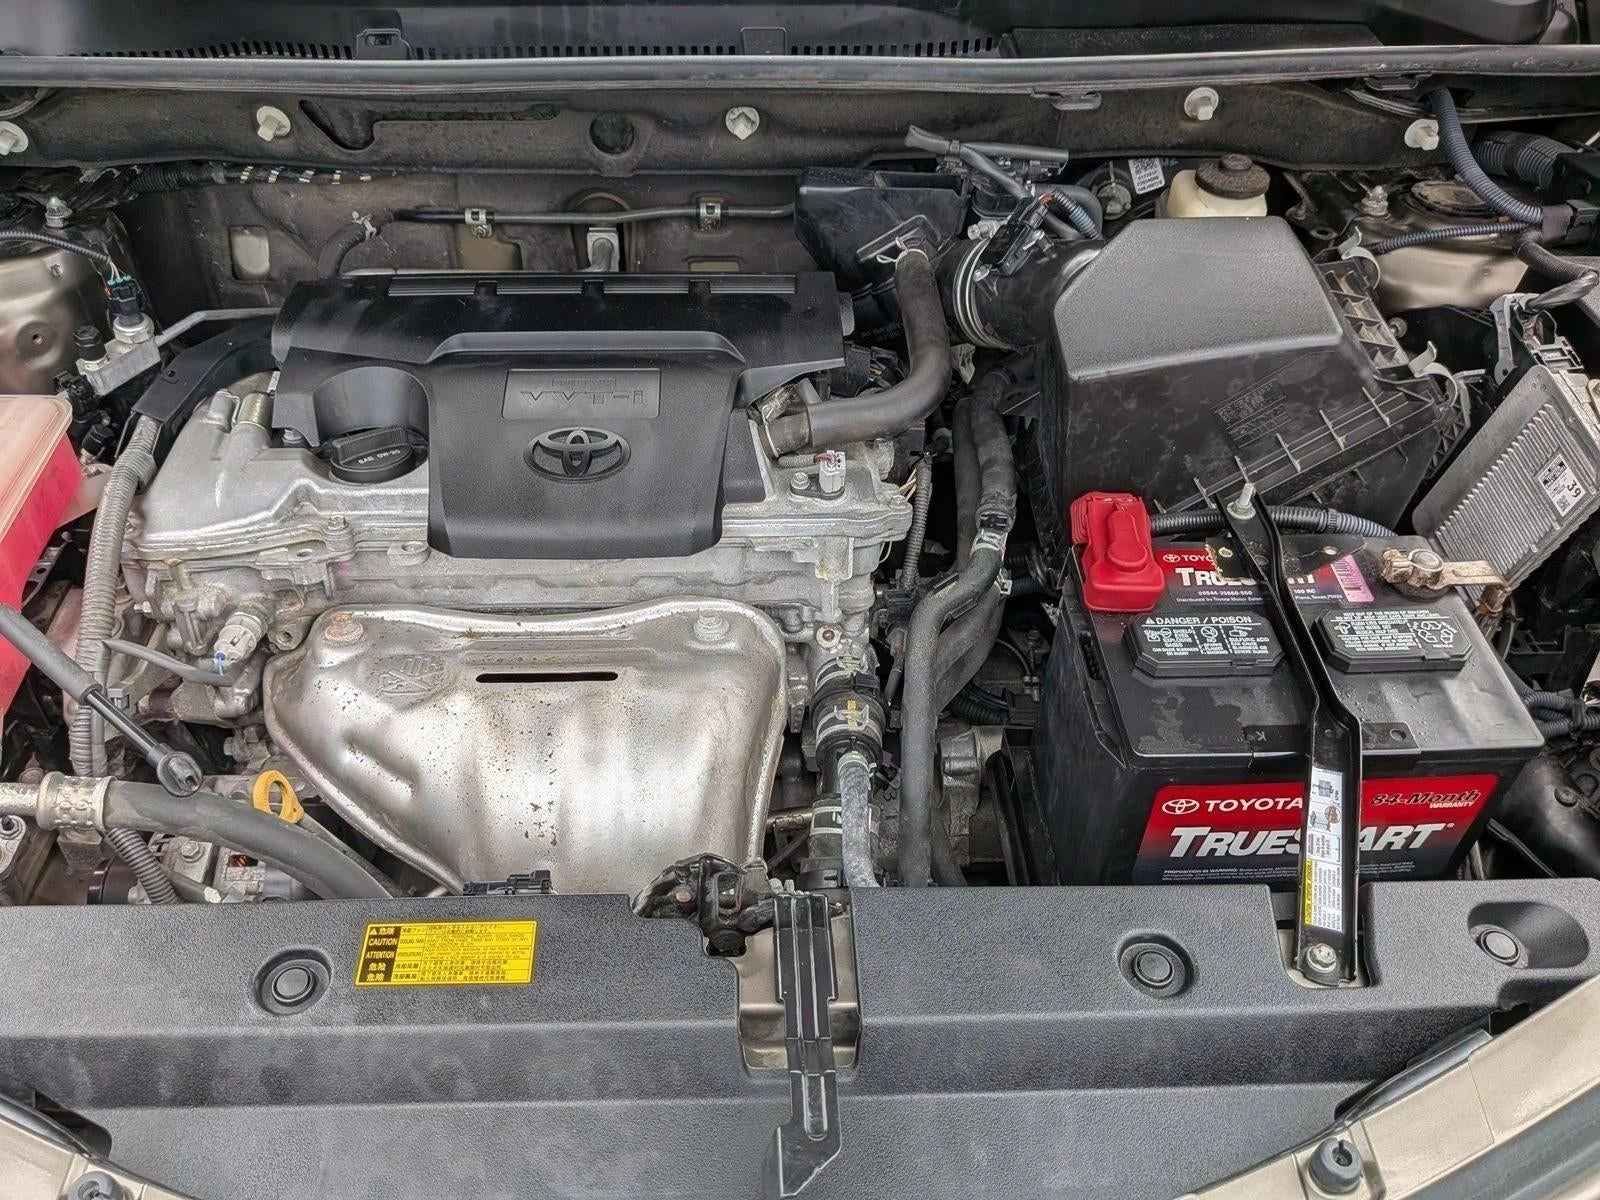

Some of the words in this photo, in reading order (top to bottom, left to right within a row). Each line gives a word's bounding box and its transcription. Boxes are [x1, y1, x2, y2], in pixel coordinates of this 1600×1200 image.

[358, 456, 375, 465] SAE
[1567, 479, 1582, 498] 39
[1156, 617, 1200, 625] DANGER
[1211, 616, 1252, 624] POISON
[1371, 789, 1481, 806] 84-Month
[1205, 797, 1303, 812] TOYOTA
[1429, 801, 1475, 809] WARRANTY
[1169, 823, 1446, 858] TRUEART
[368, 938, 398, 946] CAUTION
[366, 950, 395, 959] ATTENTION
